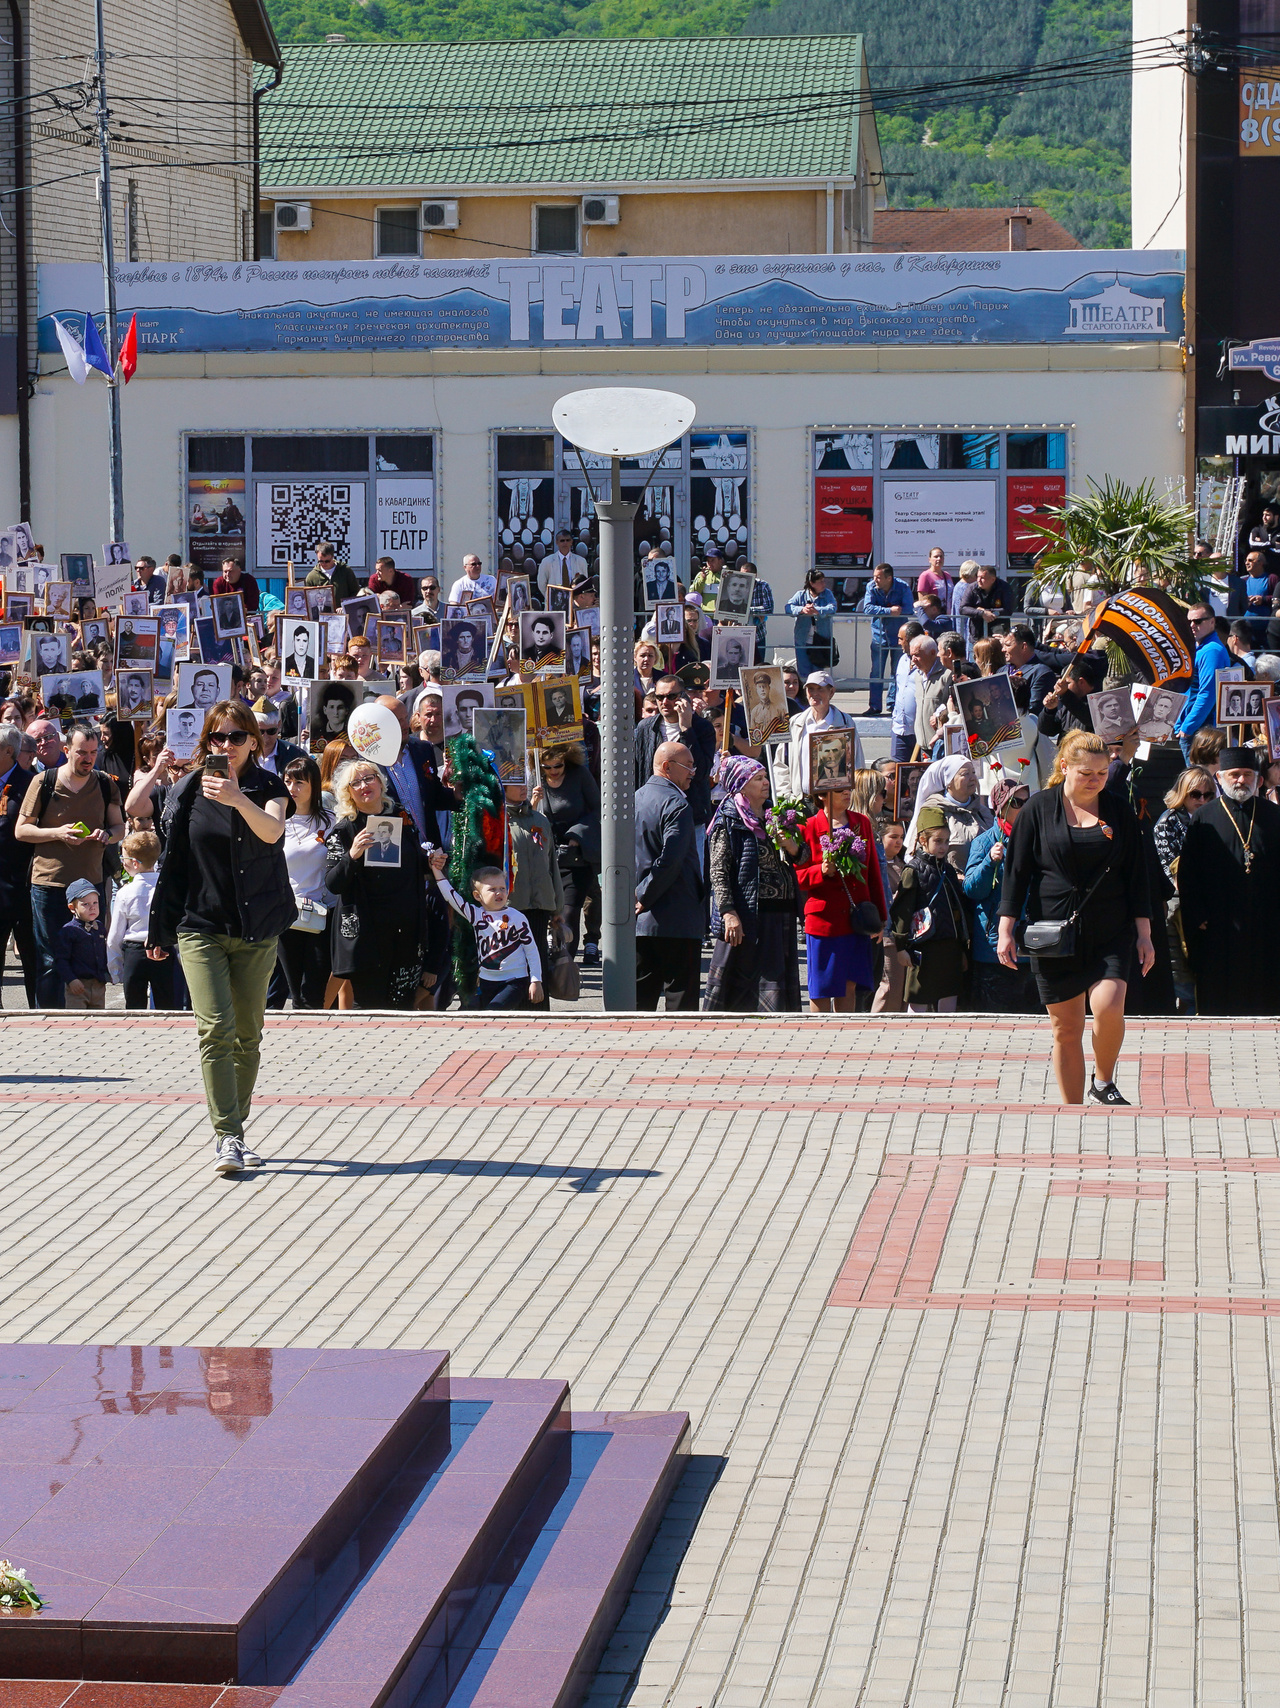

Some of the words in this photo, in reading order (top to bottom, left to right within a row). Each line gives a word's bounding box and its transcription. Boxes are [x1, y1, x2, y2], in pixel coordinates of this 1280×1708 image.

[715, 264, 726, 274] и
[729, 264, 758, 274] это
[763, 260, 836, 278] случилось
[842, 262, 851, 278] у
[893, 256, 904, 272] в
[908, 255, 1001, 278] Кабардинке
[232, 266, 242, 282] в
[246, 265, 298, 283] России
[302, 268, 370, 284] построен
[372, 263, 420, 280] новый
[423, 264, 490, 280] частный
[498, 264, 706, 340] ТЕАТР
[715, 304, 754, 314] Теперь
[778, 302, 850, 313] обязательно
[856, 304, 891, 312] ехать
[896, 302, 903, 312] в
[908, 302, 944, 312] Питер
[948, 303, 968, 311] или
[974, 302, 1010, 312] Париж
[237, 310, 301, 320] Уникальная
[306, 310, 359, 320] акустика,
[366, 310, 378, 318] не
[384, 310, 433, 318] имеющая
[438, 308, 490, 318] аналогов
[1082, 303, 1154, 322] ТЕАТР
[274, 322, 348, 332] Классическая
[354, 322, 410, 332] греческая
[416, 320, 490, 332] архитектура
[715, 316, 752, 328] Чтобы
[756, 317, 816, 327] окунуться
[822, 316, 828, 325] в
[833, 317, 854, 326] мир
[859, 316, 912, 326] Высокого
[142, 332, 178, 344] ПАРК
[334, 334, 406, 344] внутреннего
[411, 332, 490, 342] пространства
[715, 329, 743, 339] Одна
[748, 330, 760, 338] из
[766, 330, 806, 340] лучших
[811, 328, 866, 338] площадок
[872, 328, 900, 338] мира
[904, 328, 927, 338] уже
[1234, 354, 1248, 364] ул.
[378, 498, 384, 506] В
[385, 497, 430, 506] КАБАРДИНКЕ
[392, 512, 416, 525] ЕСТЬ
[380, 530, 428, 550] ТЕАТР
[105, 584, 124, 599] ПОЛК
